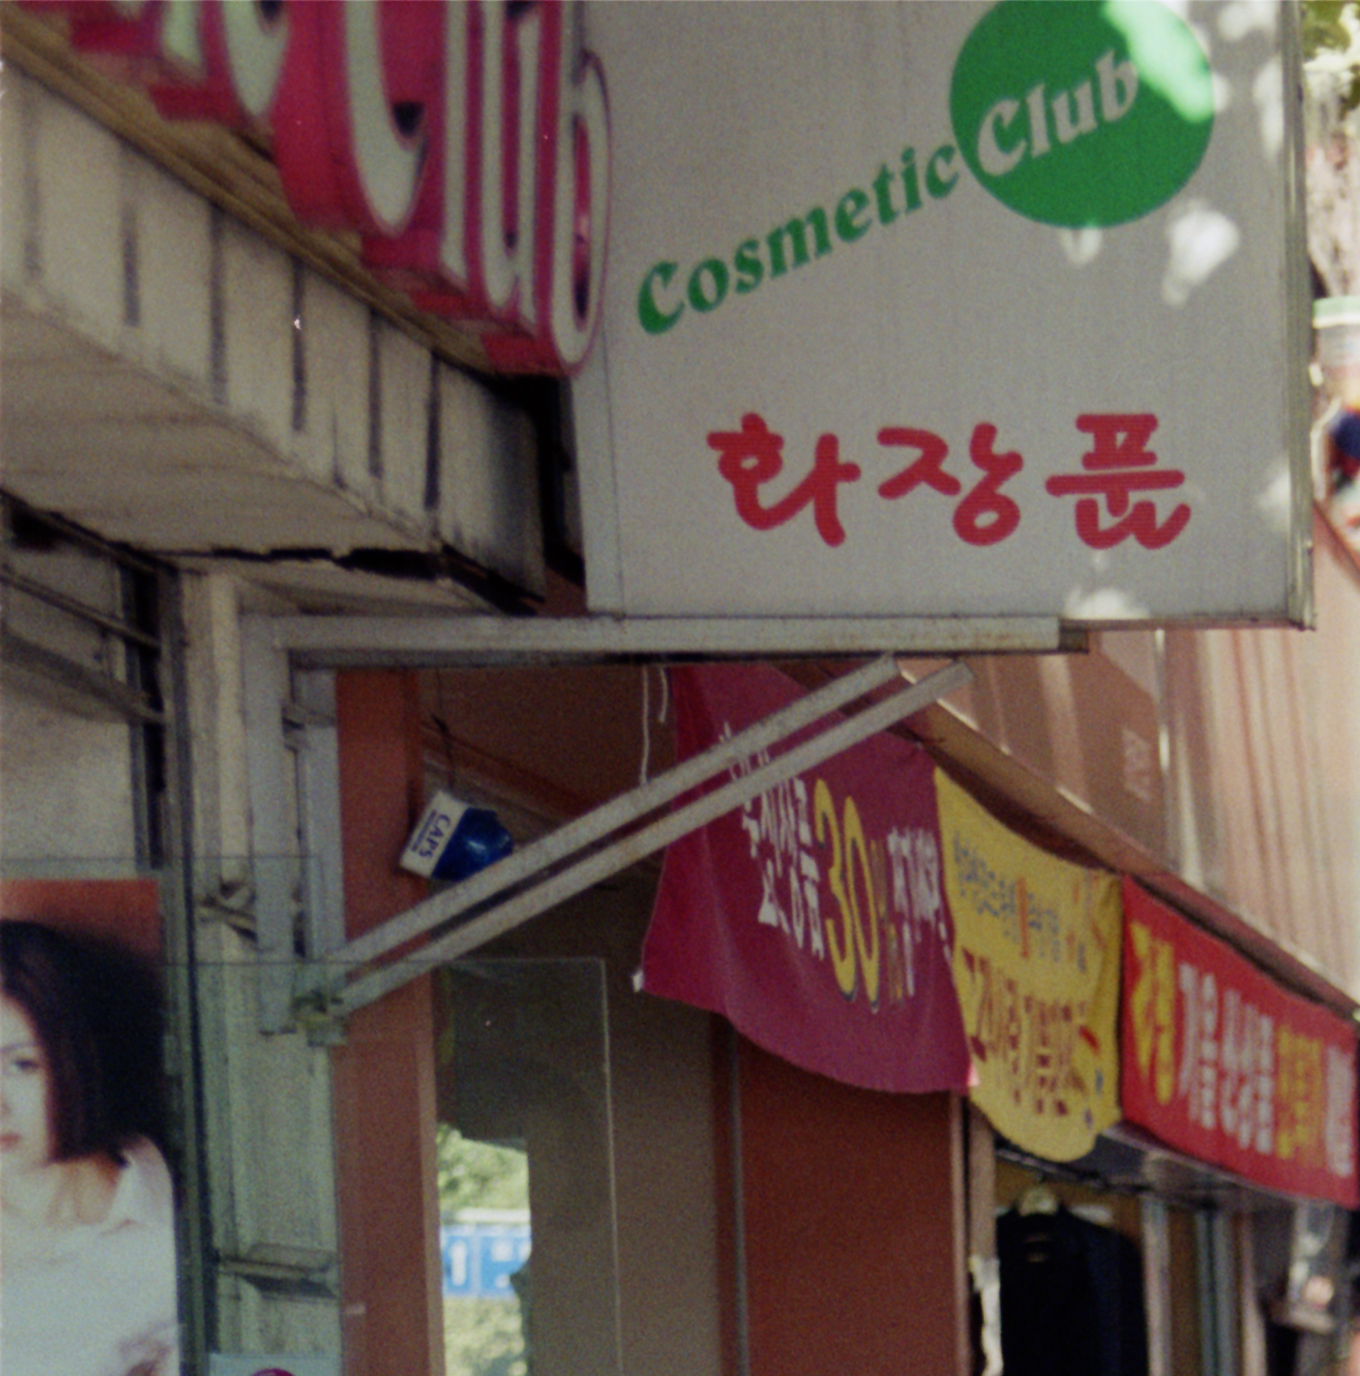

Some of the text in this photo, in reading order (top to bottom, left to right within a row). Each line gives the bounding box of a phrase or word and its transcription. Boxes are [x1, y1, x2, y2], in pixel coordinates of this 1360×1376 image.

[636, 51, 1139, 335] Cosmetic Club
[706, 412, 1191, 550] 화장품
